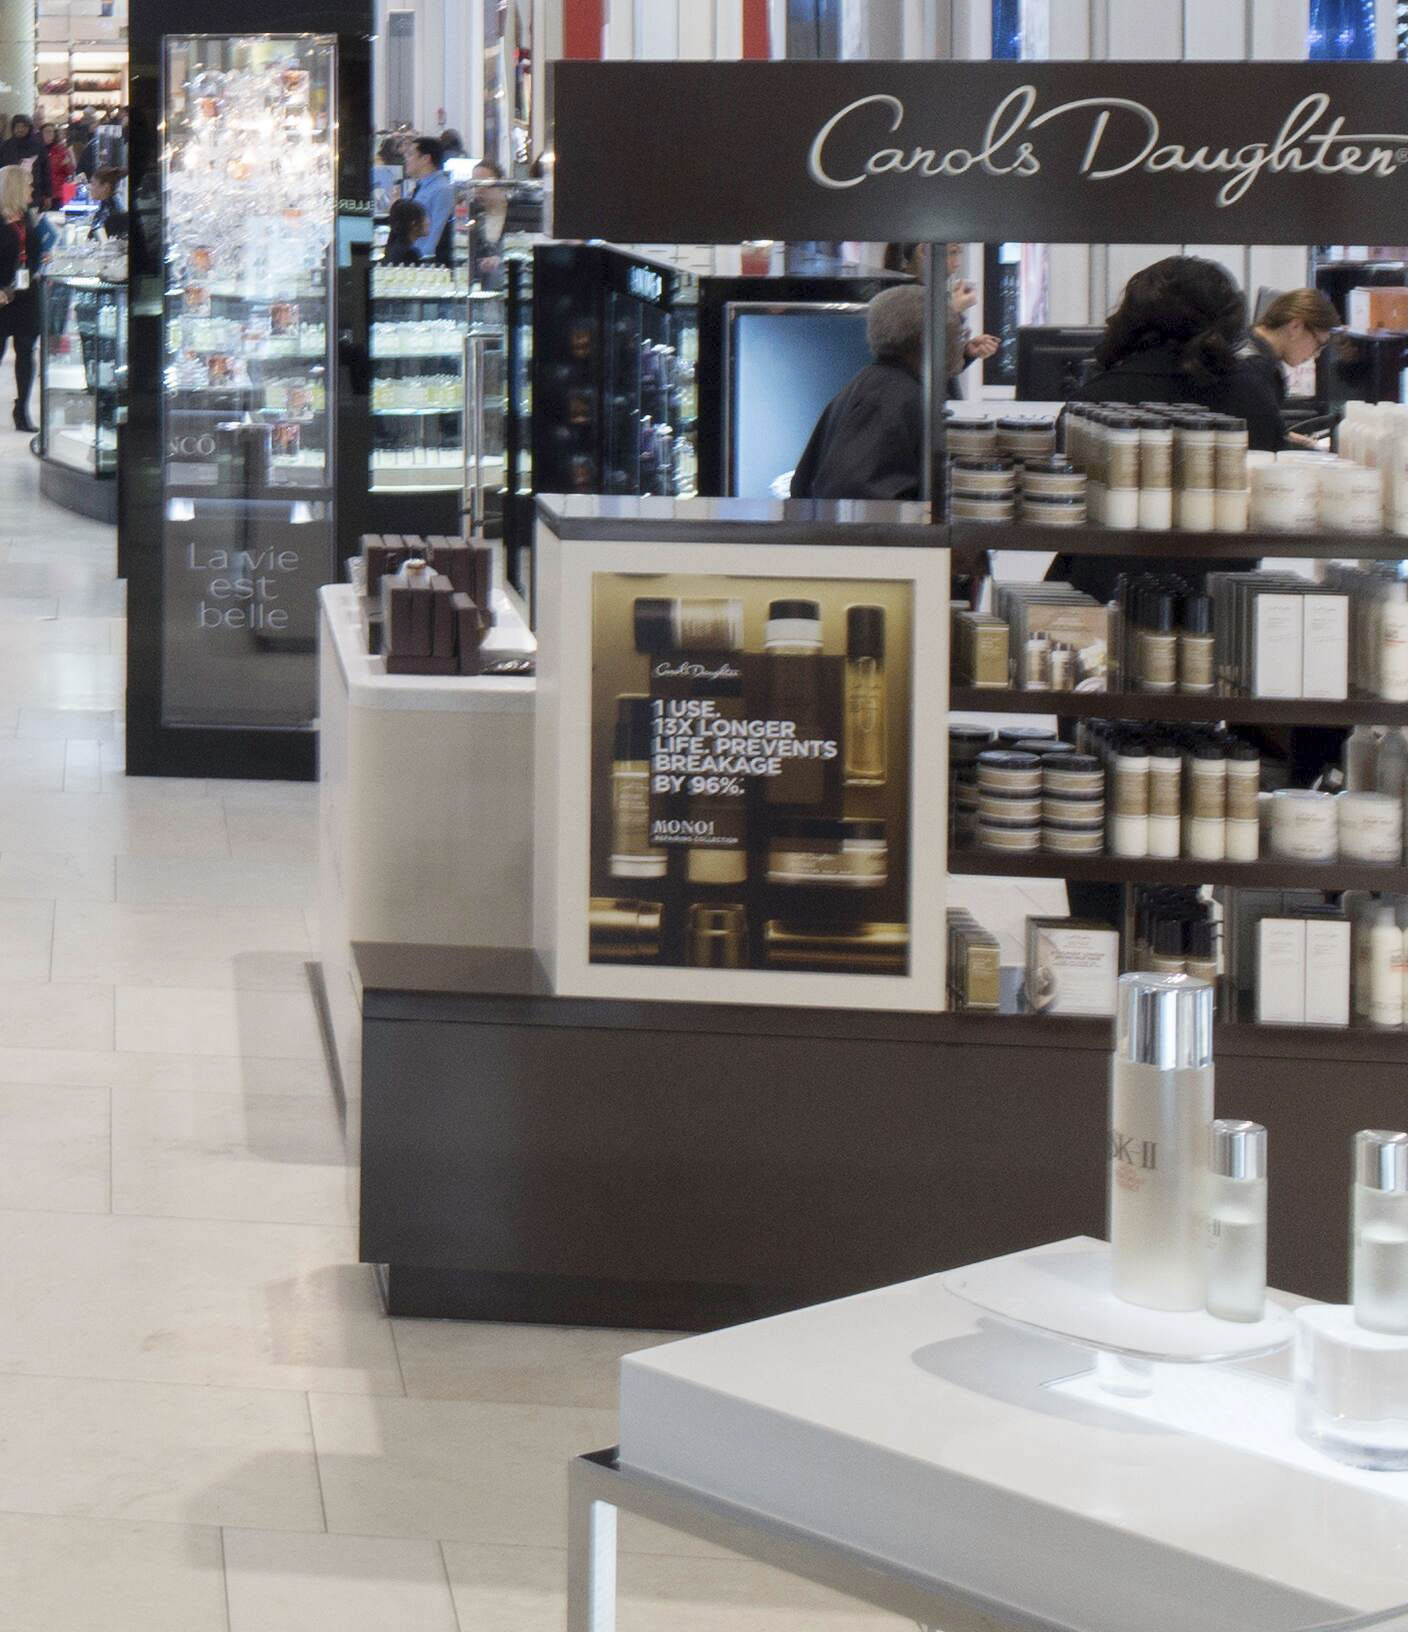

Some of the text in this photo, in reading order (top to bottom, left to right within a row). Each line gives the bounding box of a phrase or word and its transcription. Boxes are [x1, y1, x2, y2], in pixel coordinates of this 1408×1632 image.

[1029, 92, 1408, 208] Daughter
[189, 542, 300, 572] La vie
[210, 575, 279, 600] est
[199, 601, 290, 629] belle
[652, 699, 722, 718] 1 USE.
[652, 719, 797, 738] 13X LONGER
[652, 736, 839, 759] LIFE. PREVENTS
[653, 754, 784, 776] BREAKAGE
[653, 775, 685, 794] BY
